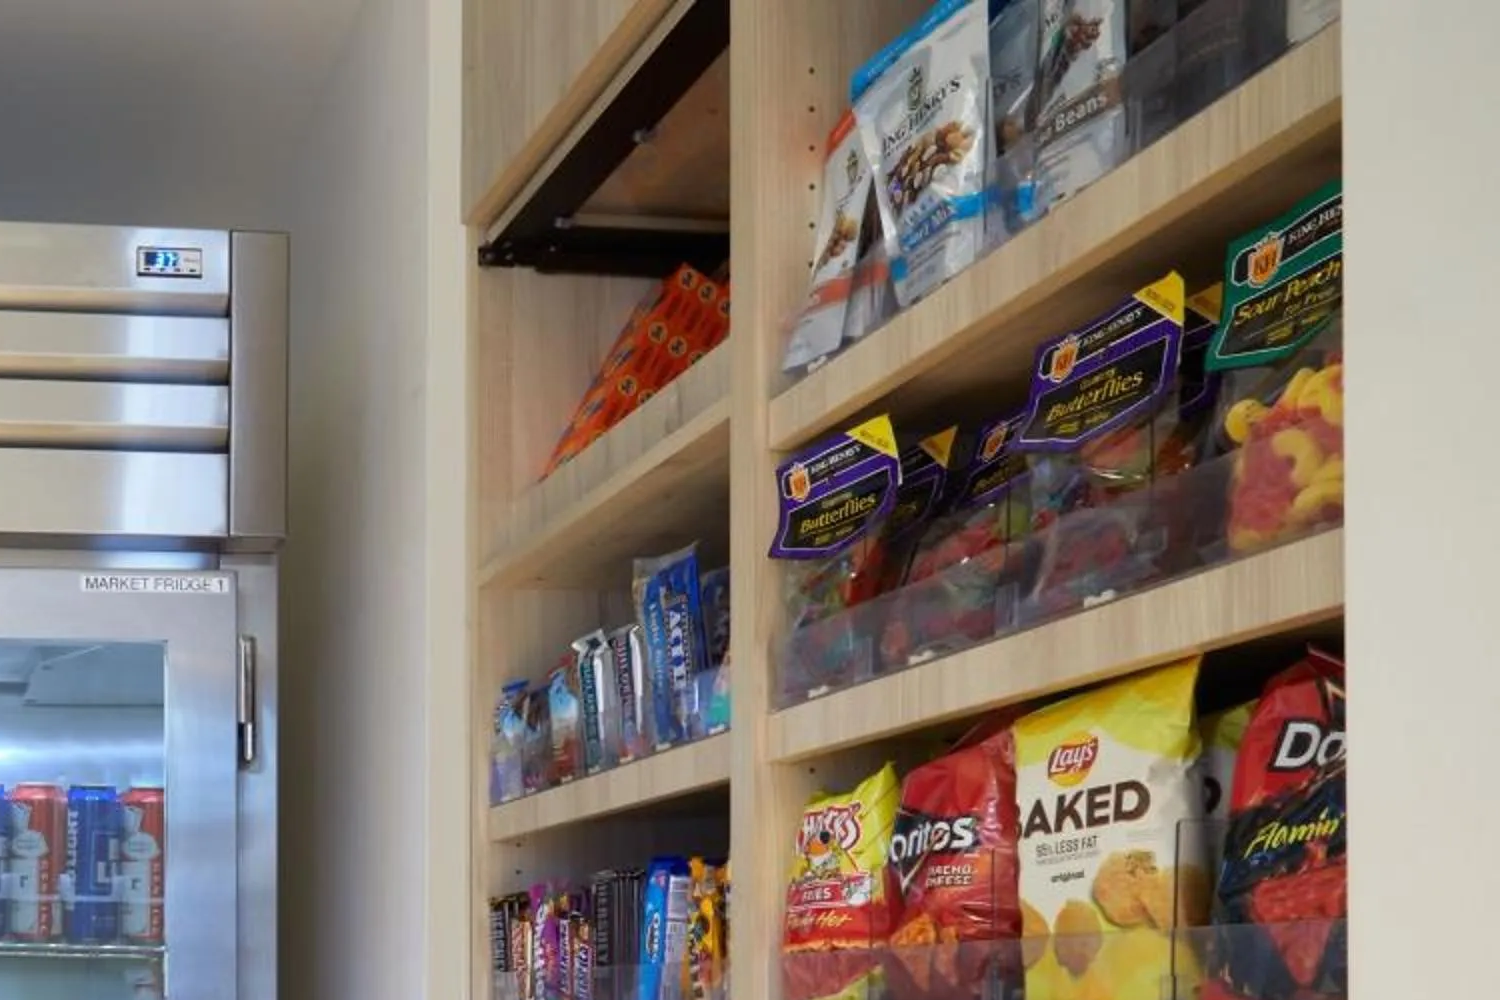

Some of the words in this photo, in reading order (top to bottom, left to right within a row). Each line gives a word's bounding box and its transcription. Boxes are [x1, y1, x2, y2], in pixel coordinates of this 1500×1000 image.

[1055, 93, 1107, 134] Beans
[1045, 370, 1144, 422] Butterflies
[800, 493, 877, 533] Butterflies
[84, 577, 149, 591] MARKET
[153, 577, 212, 591] FRIDGE
[217, 577, 224, 592] 1
[1051, 738, 1097, 773] Lay's
[1018, 779, 1152, 839] AKED
[890, 817, 975, 862] oritos
[1054, 838, 1079, 855] LESS
[1081, 835, 1099, 850] FAT
